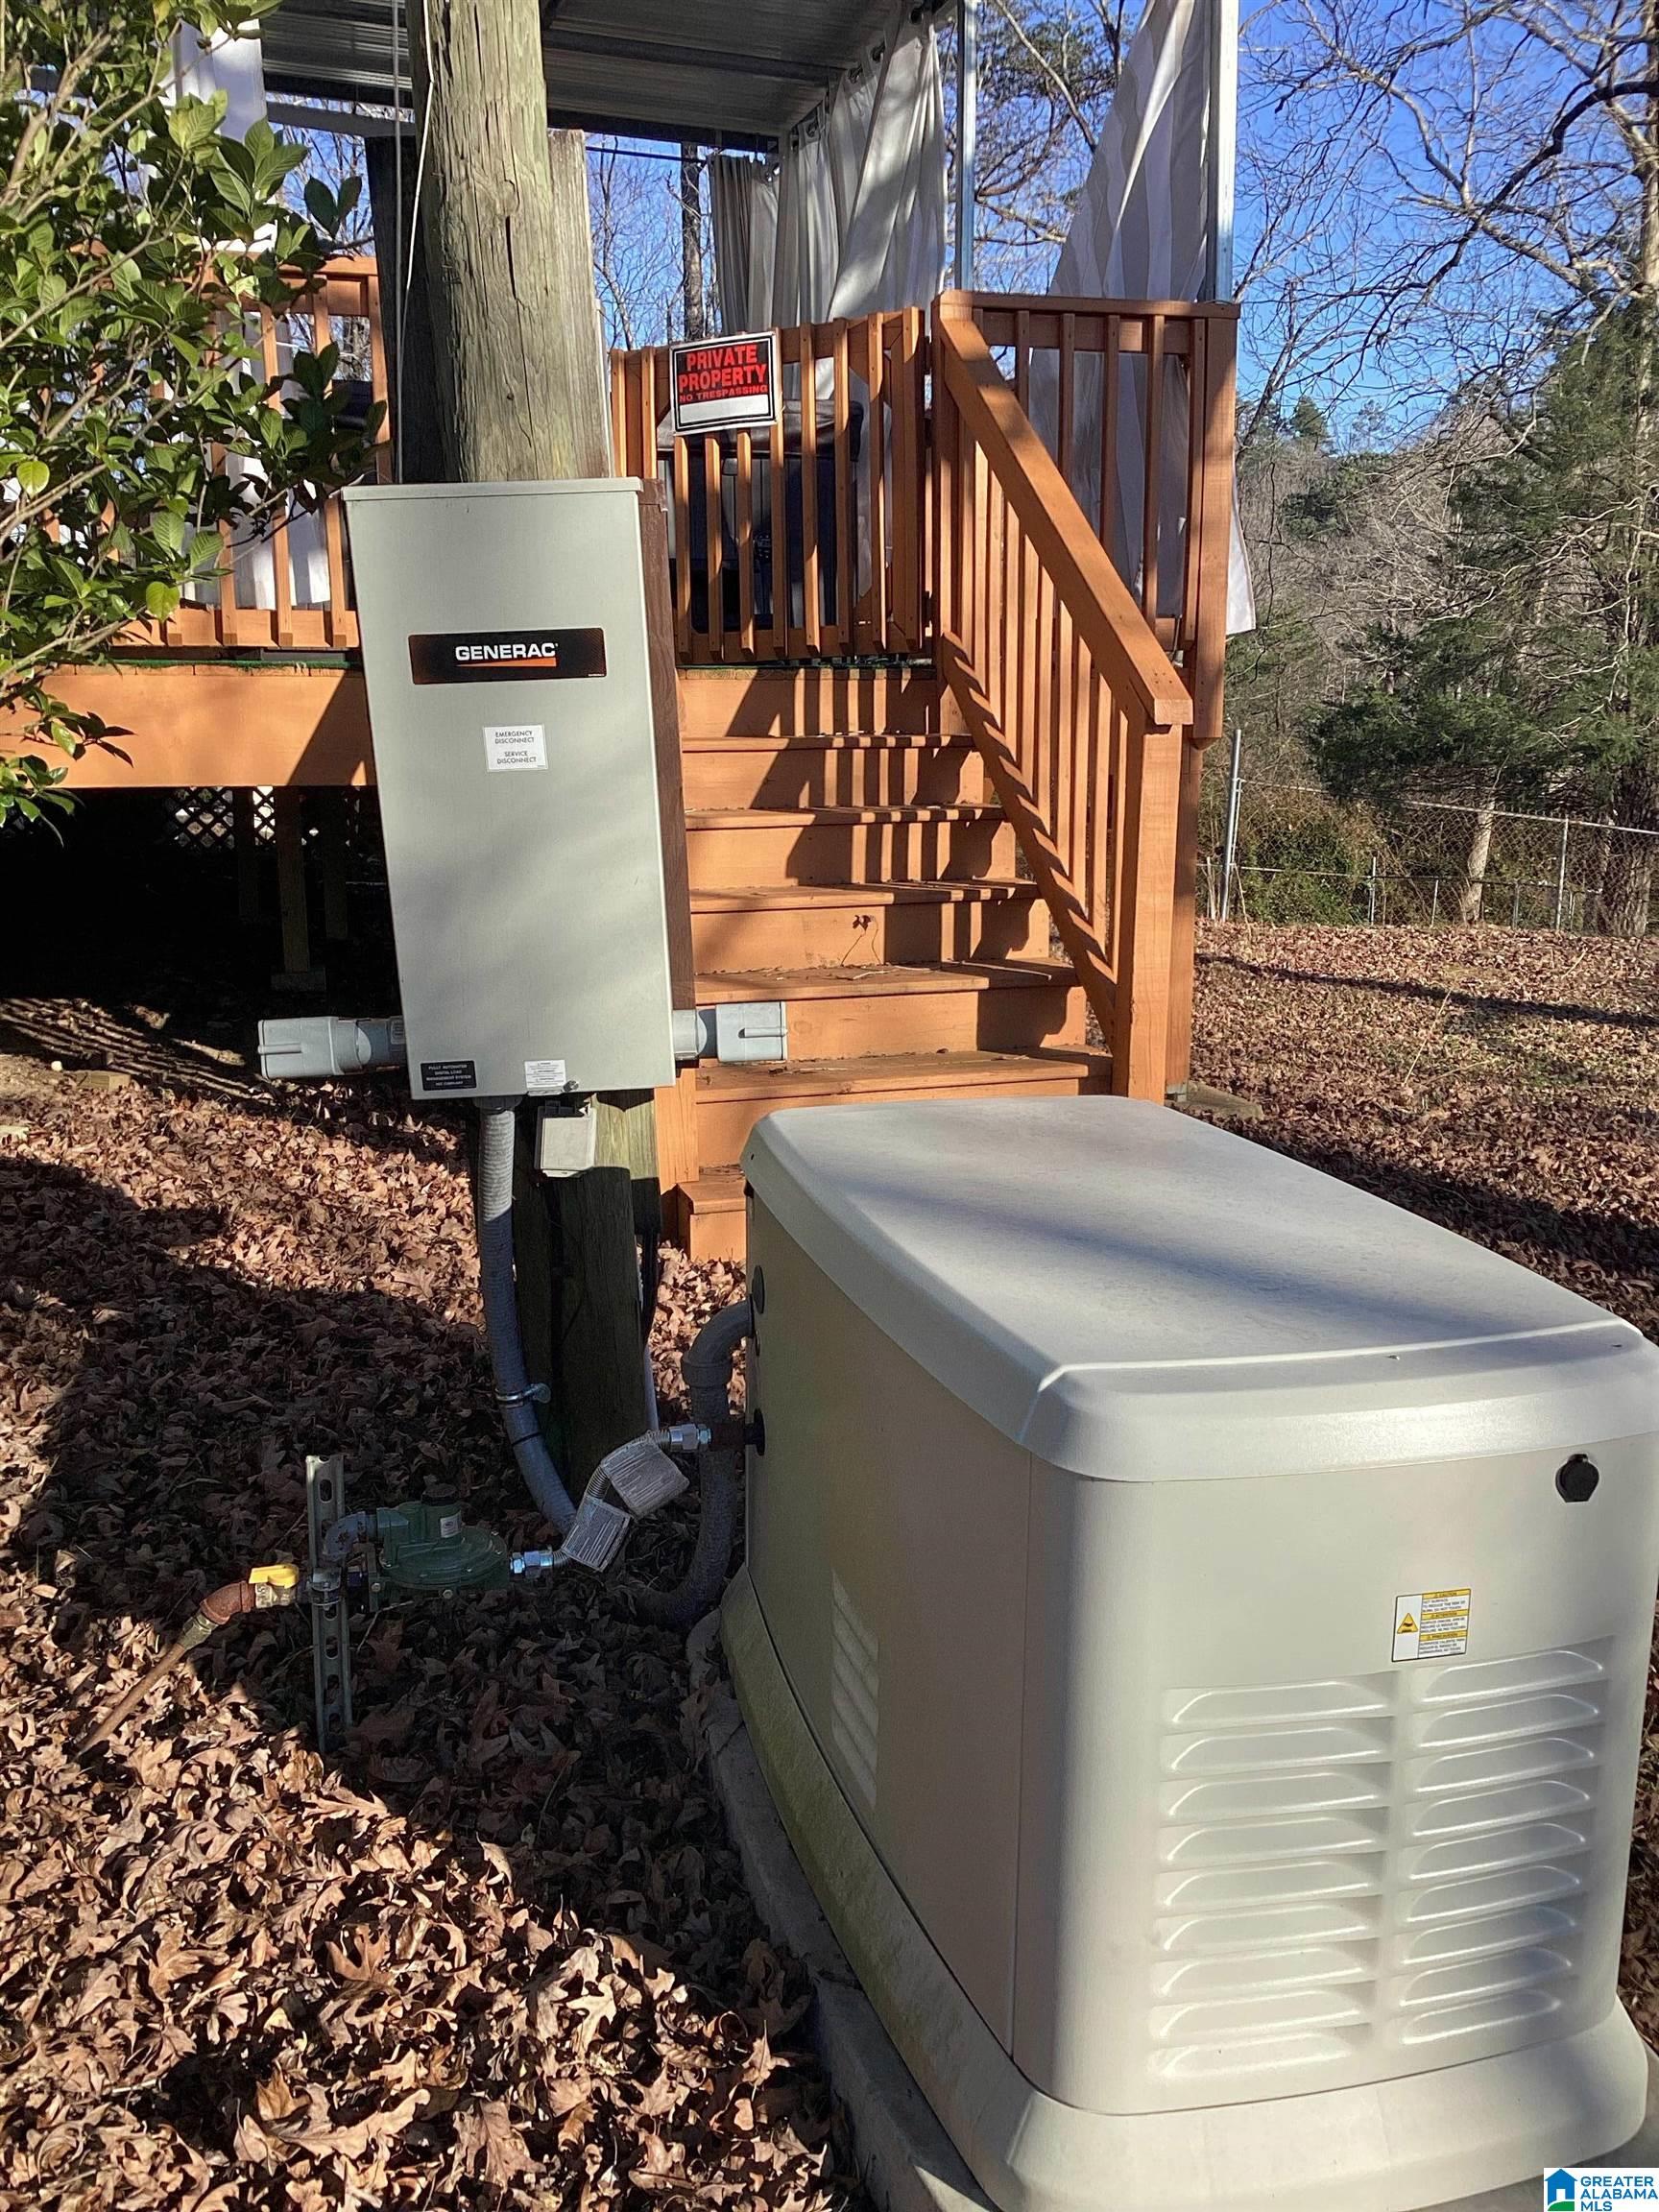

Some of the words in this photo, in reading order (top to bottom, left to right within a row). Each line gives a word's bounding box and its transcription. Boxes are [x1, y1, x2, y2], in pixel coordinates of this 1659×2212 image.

[687, 345, 757, 371] PRIVATE
[679, 364, 766, 392] PROPERTY
[679, 394, 693, 402] NO
[696, 384, 768, 400] TRESPASSING
[455, 642, 556, 661] GENERAC
[494, 730, 533, 738] EMERGENCY
